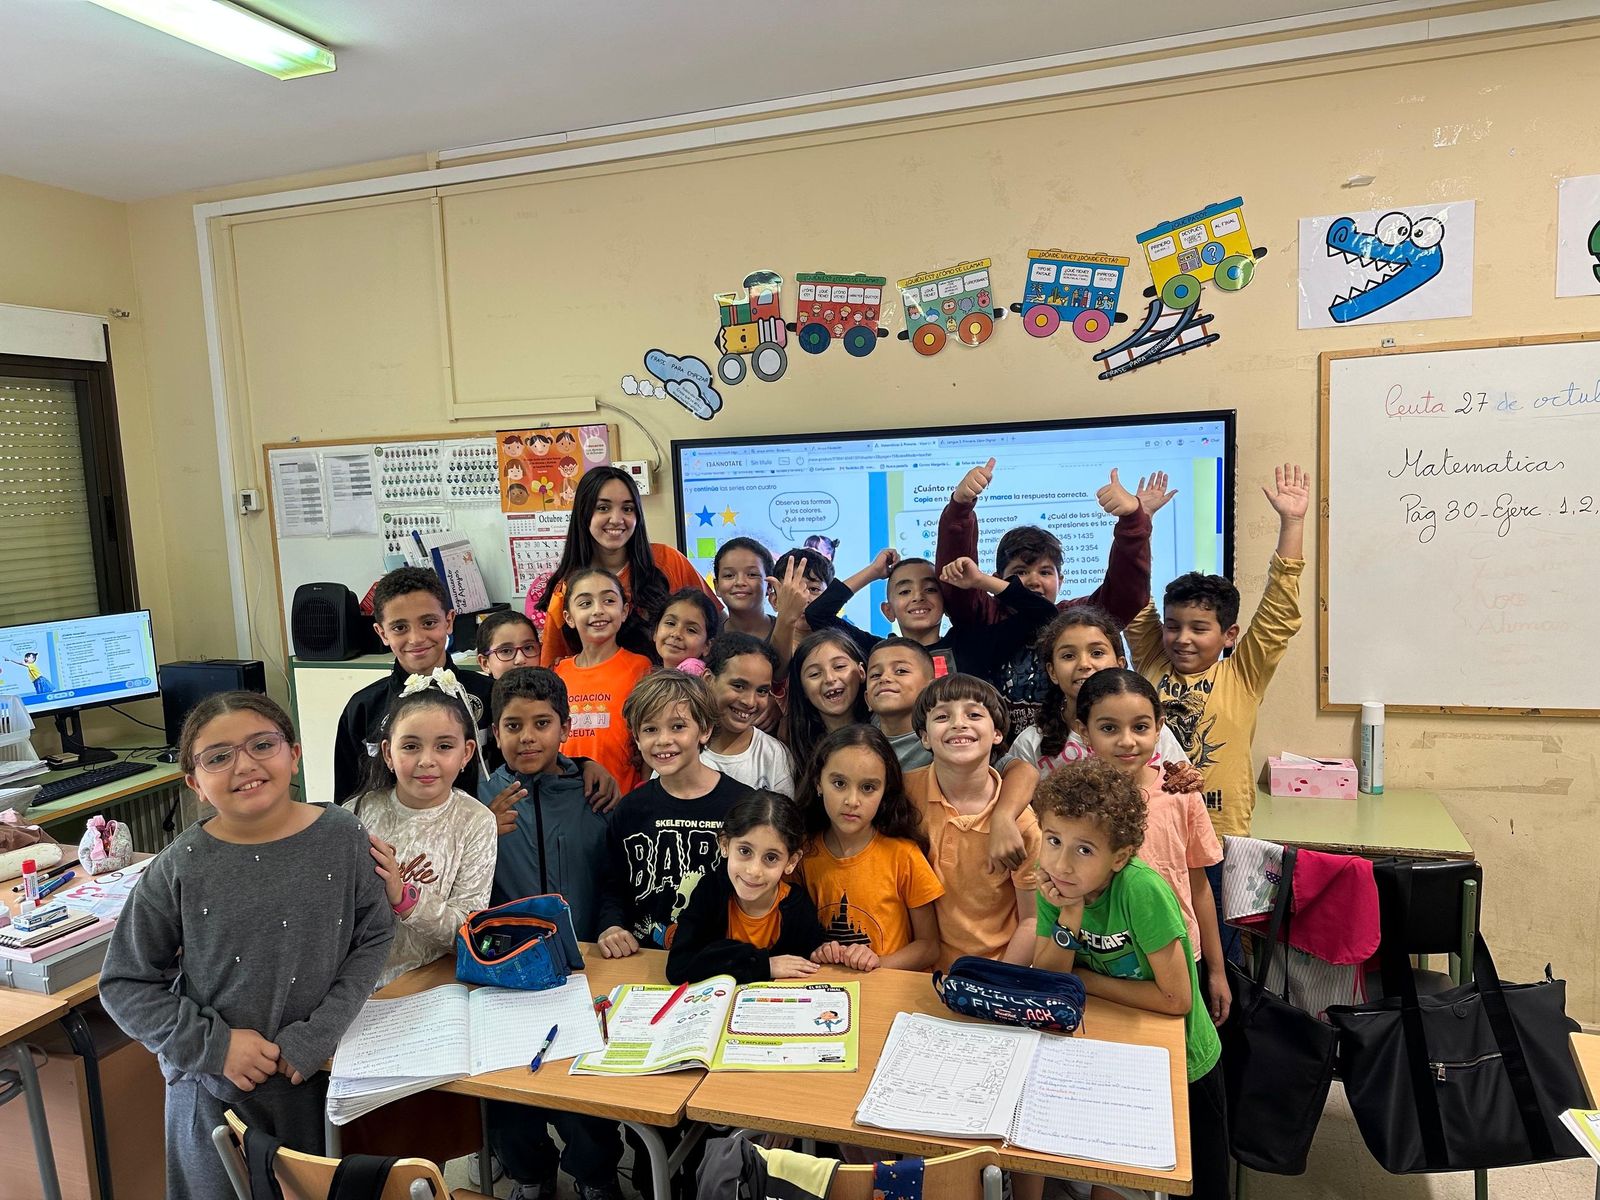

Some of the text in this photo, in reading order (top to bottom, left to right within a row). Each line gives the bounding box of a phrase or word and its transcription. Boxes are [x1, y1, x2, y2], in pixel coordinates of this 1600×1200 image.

[1129, 356, 1146, 368] PARA
[1147, 333, 1176, 356] TERMINAR
[1454, 391, 1490, 414] 27
[1496, 391, 1524, 411] de
[913, 484, 945, 494] ¿Cuánto
[913, 495, 933, 505] Copia
[1021, 492, 1056, 502] respuesta
[1056, 491, 1088, 499] correcta.
[775, 498, 800, 506] Observa
[538, 514, 563, 523] Octubre
[986, 515, 1018, 523] correcta?
[1047, 512, 1068, 521] ¿Cuál
[1047, 521, 1089, 530] expresiones
[568, 693, 611, 703] OCIACIÓN
[655, 819, 724, 829] SKELETON CREW
